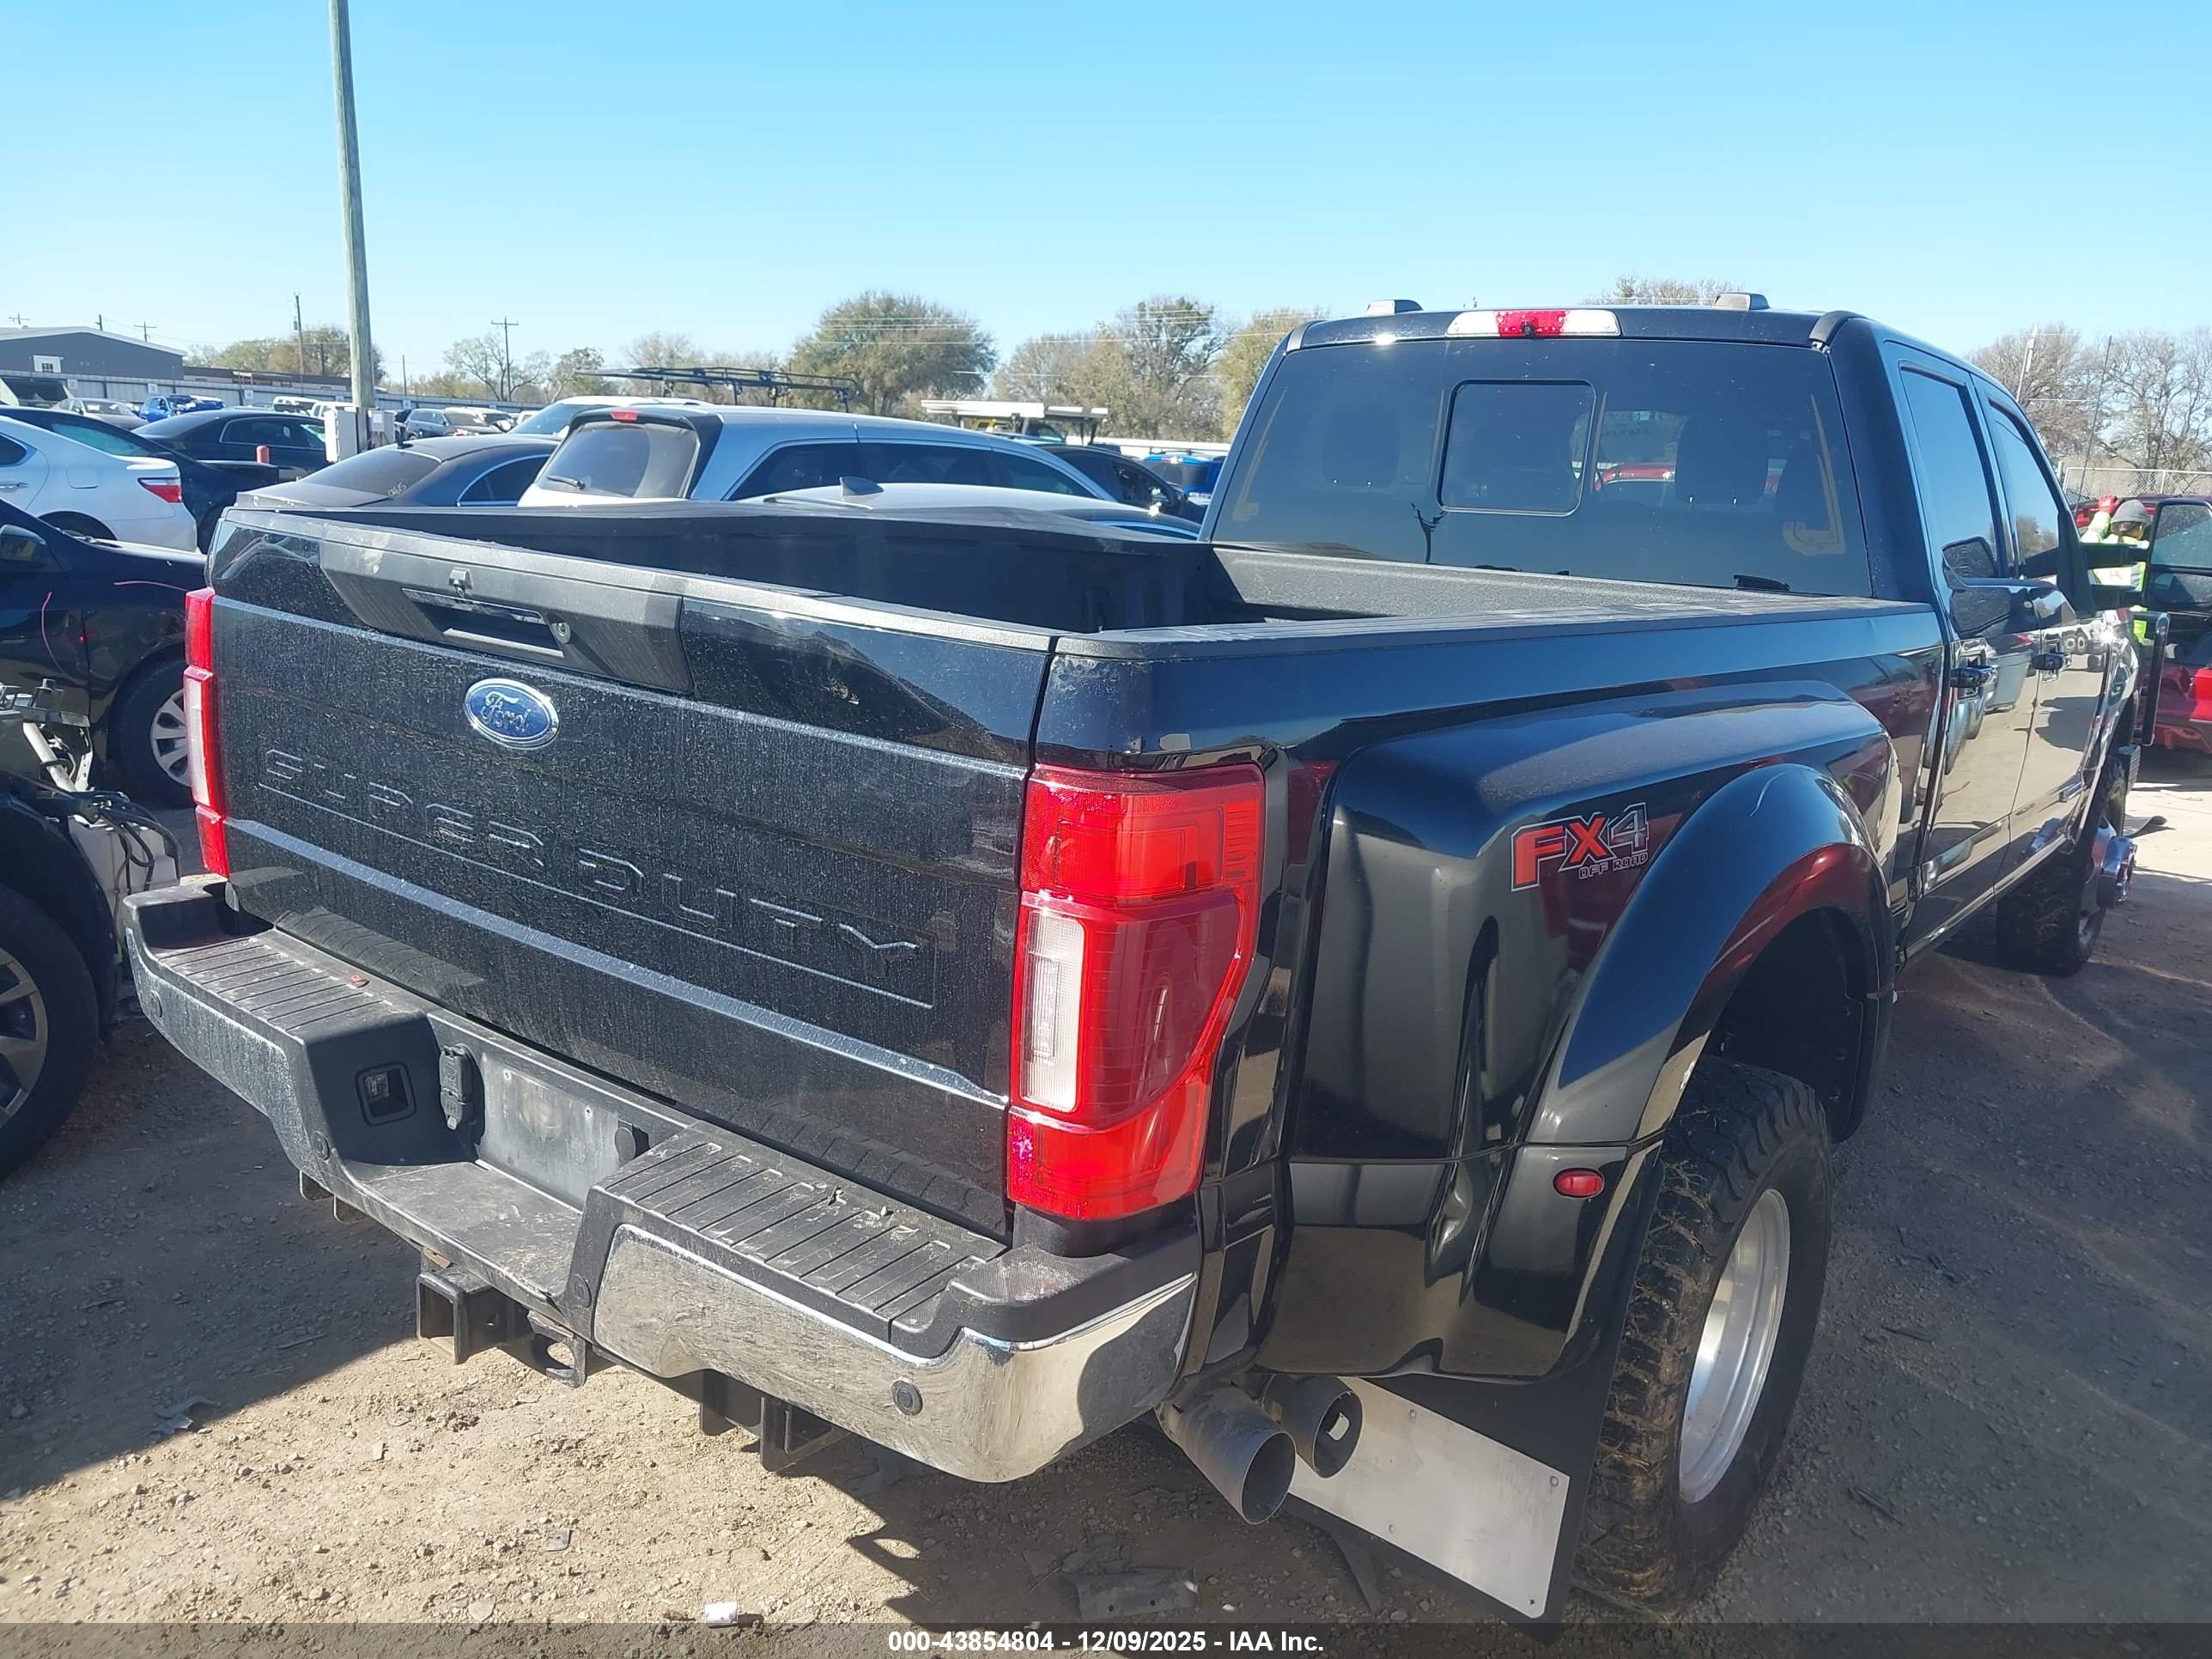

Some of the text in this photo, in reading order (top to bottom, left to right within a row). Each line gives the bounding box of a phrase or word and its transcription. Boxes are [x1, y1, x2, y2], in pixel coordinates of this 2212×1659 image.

[481, 690, 532, 732] Ford
[264, 749, 921, 976] SUPER DUTY
[1511, 802, 1649, 892] FX4
[1579, 853, 1648, 879] OFF ROAD
